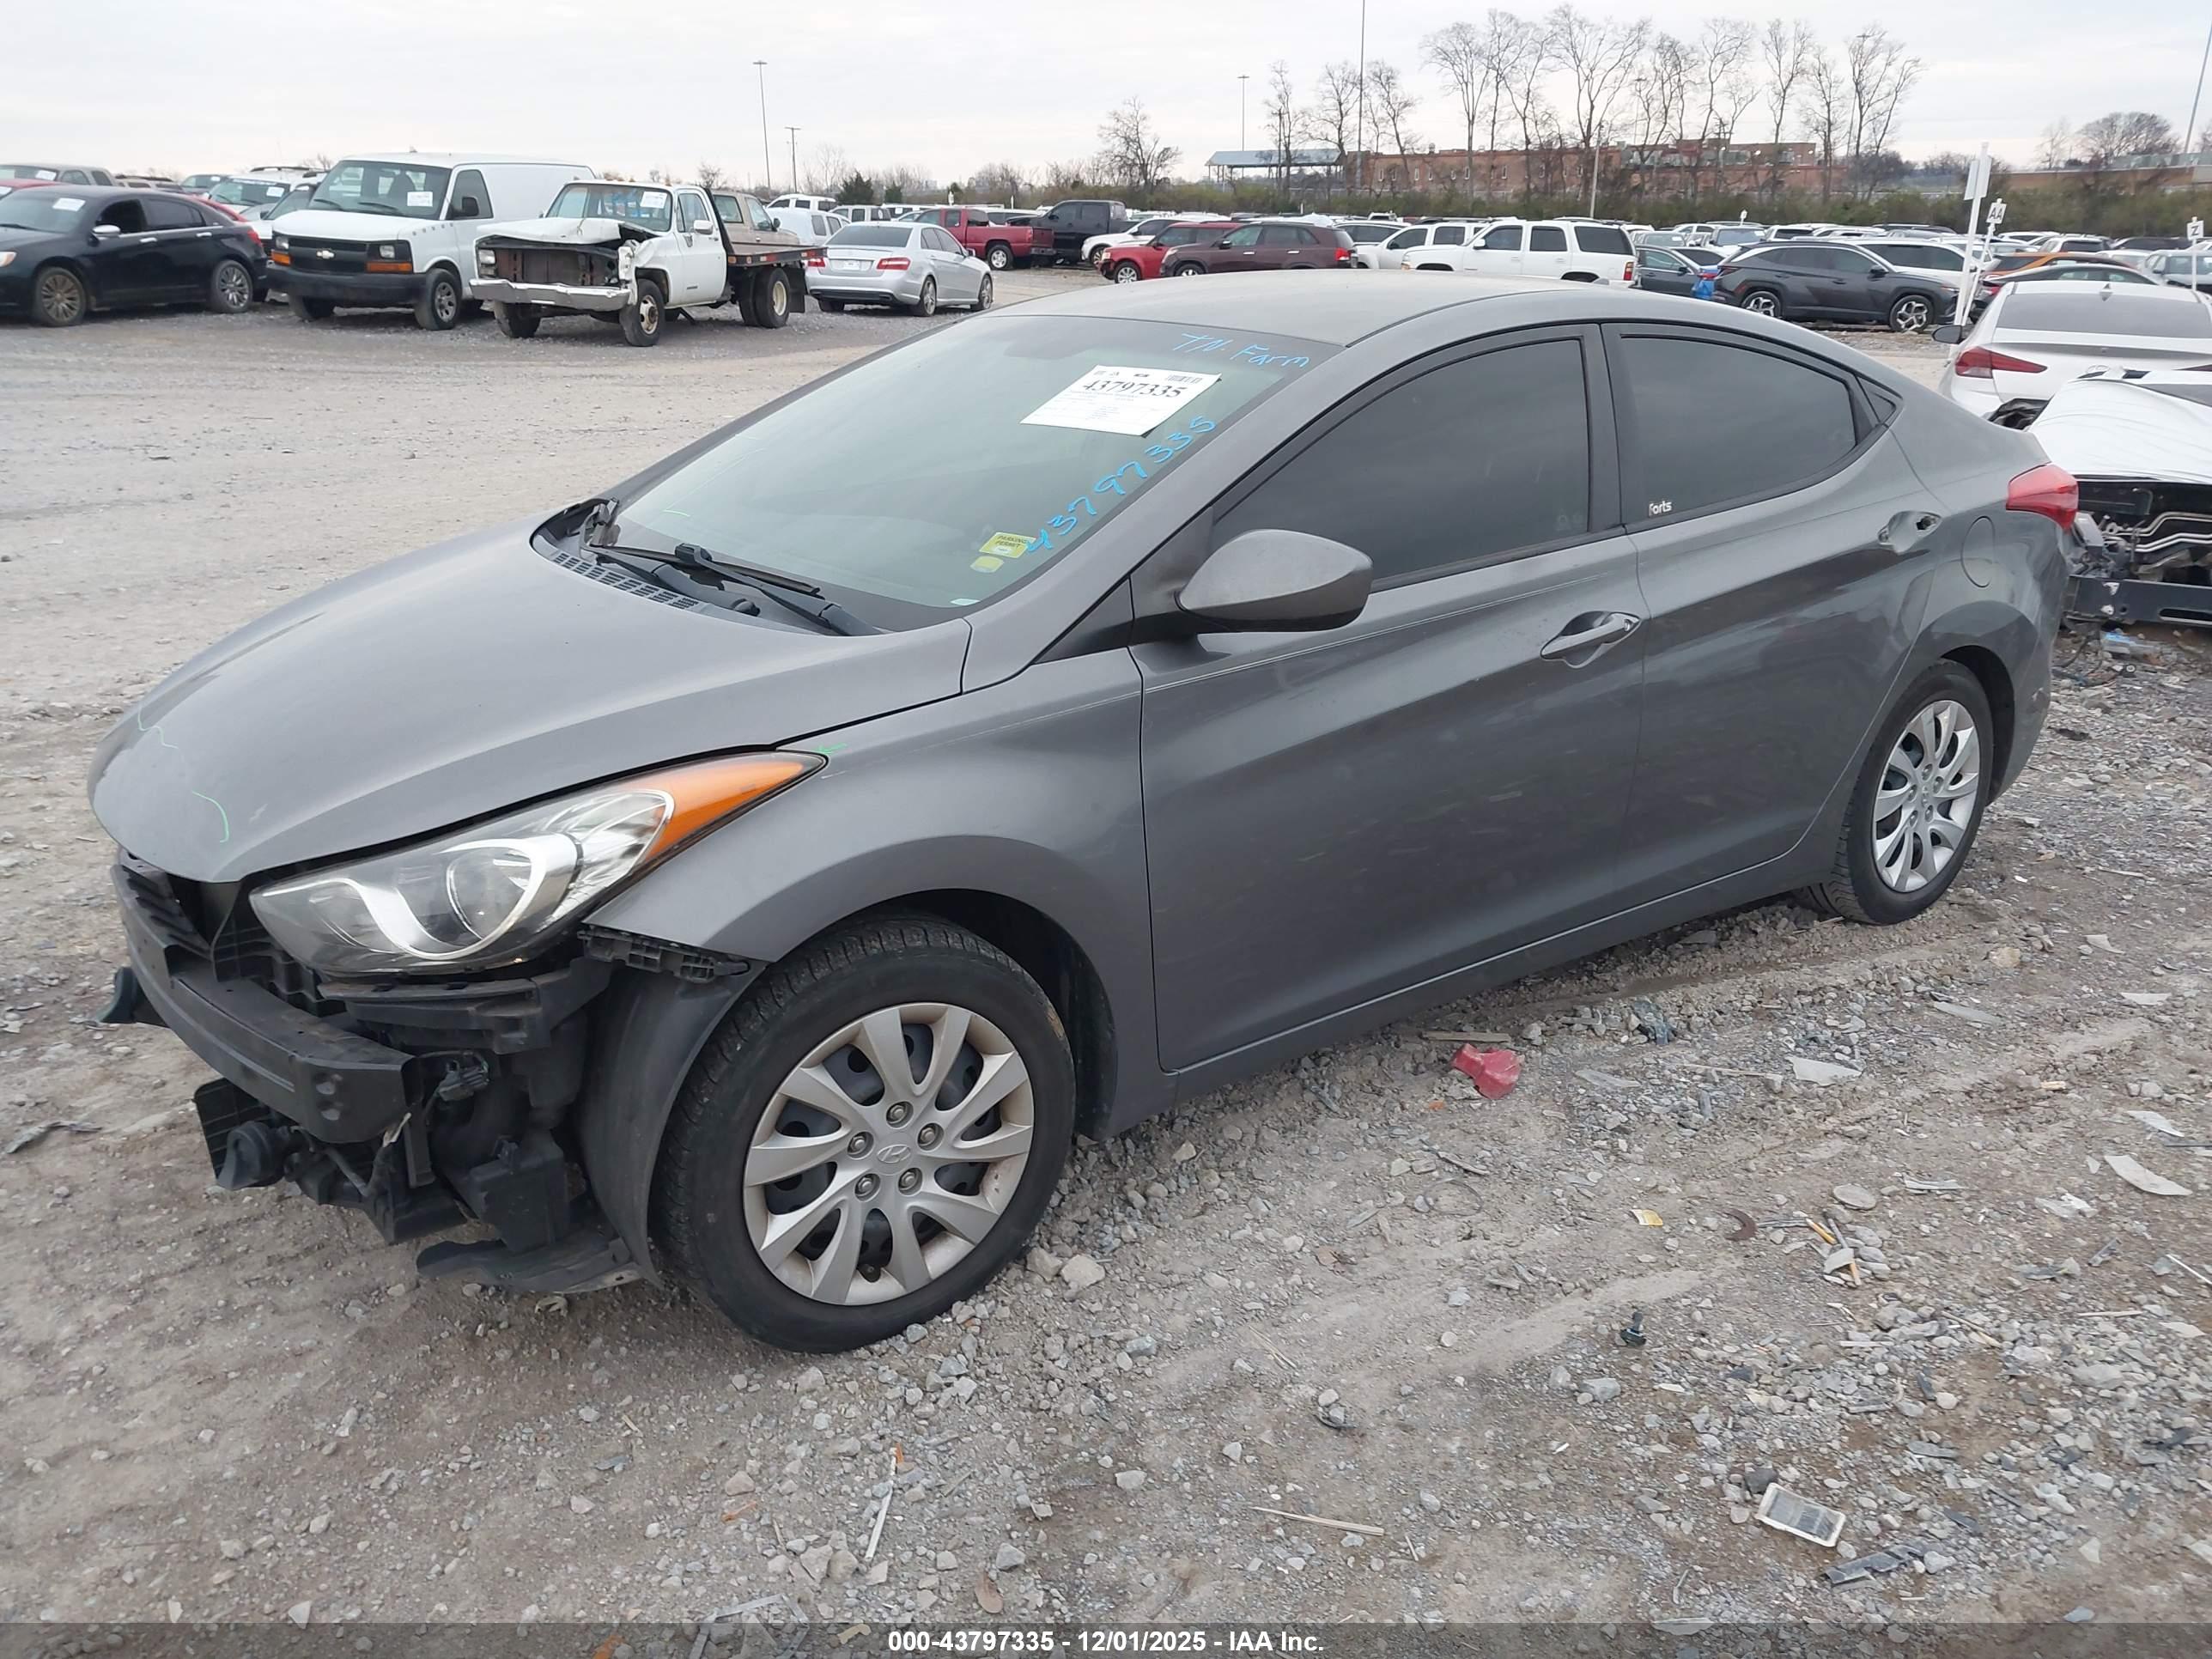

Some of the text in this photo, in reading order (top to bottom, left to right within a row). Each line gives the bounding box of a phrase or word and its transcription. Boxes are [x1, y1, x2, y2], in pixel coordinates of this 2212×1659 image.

[1989, 207, 2002, 220] AA
[2191, 225, 2200, 236] Z
[1230, 344, 1310, 368] Farm
[1083, 379, 1188, 398] 43797335
[1027, 416, 1216, 552] 43797335
